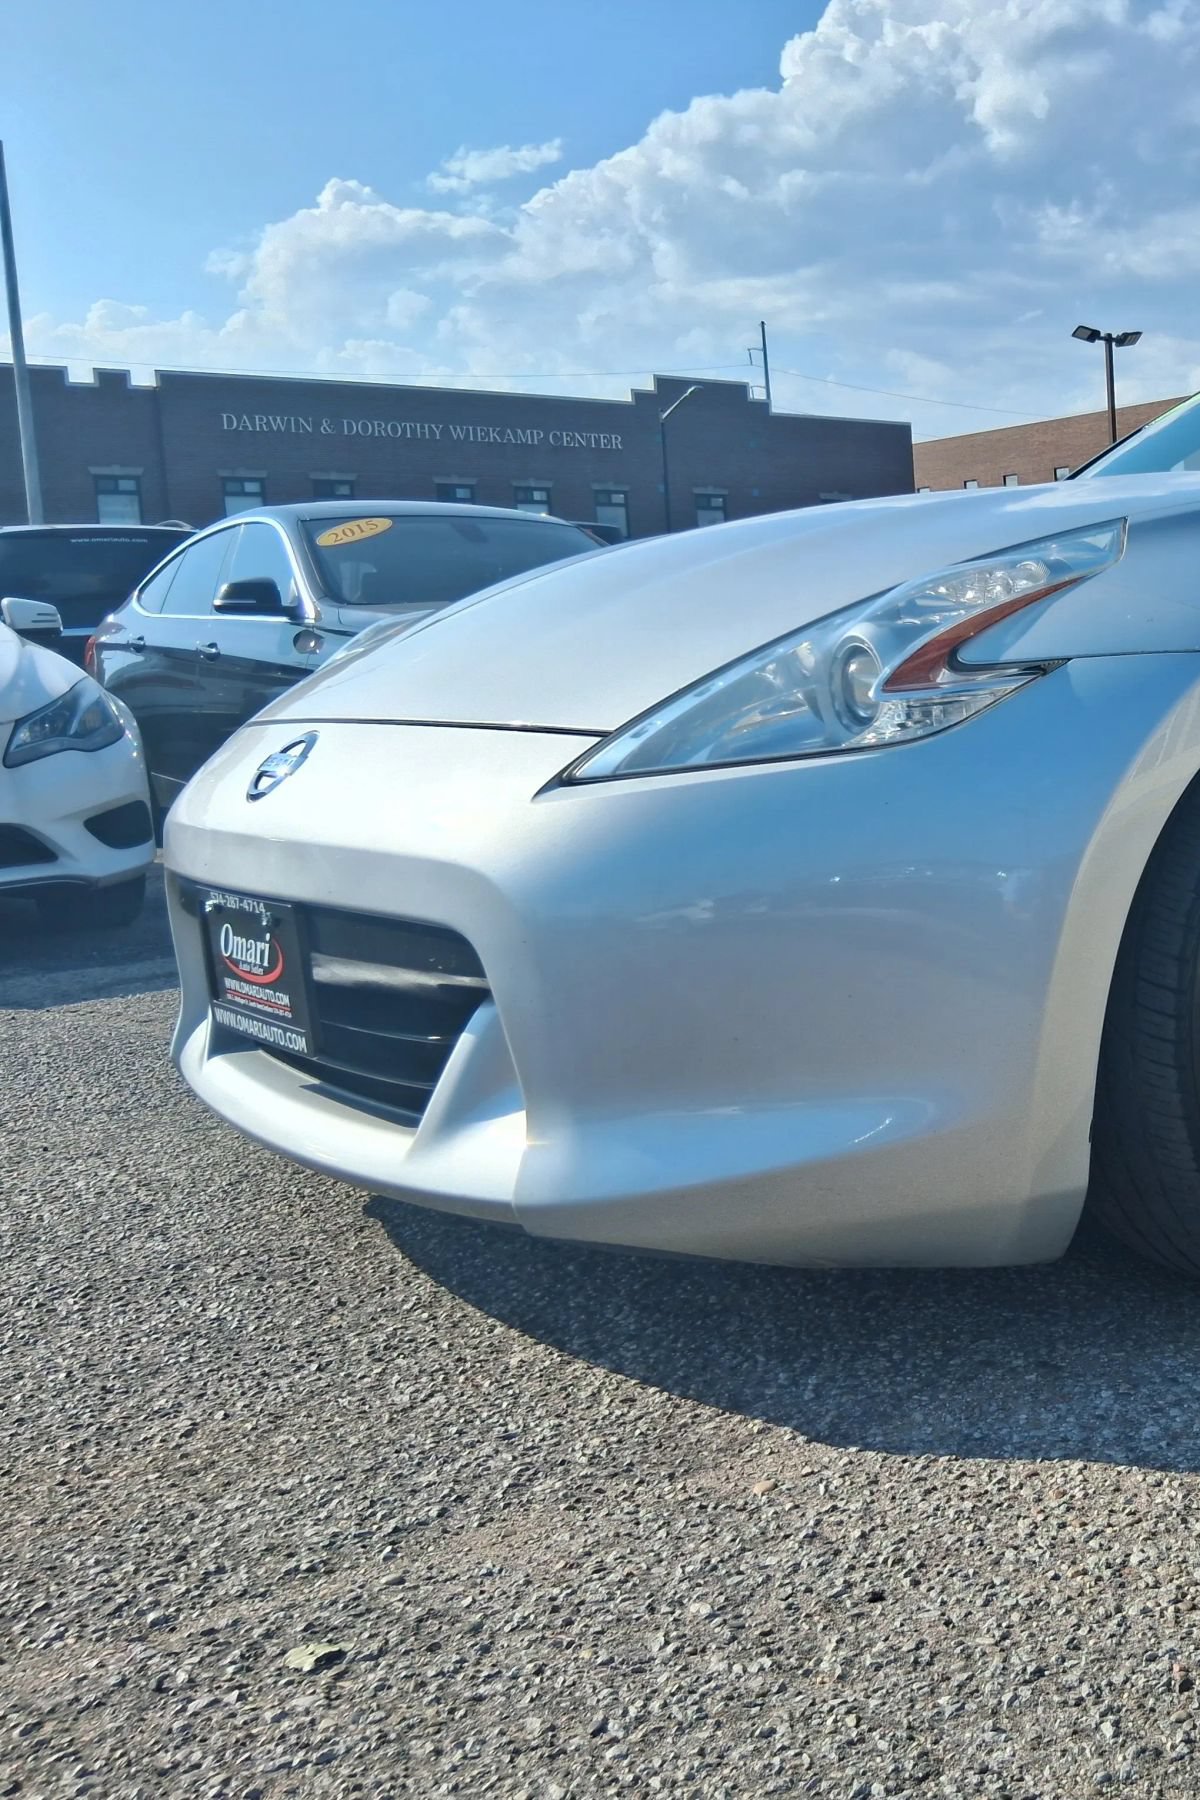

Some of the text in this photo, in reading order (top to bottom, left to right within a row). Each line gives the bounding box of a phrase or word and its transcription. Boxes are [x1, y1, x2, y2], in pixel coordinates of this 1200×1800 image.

[221, 413, 623, 450] DARWIN & DOROTHY WIEKAMP CENTER
[328, 520, 379, 543] 2015
[221, 923, 270, 966] Omari
[214, 1007, 307, 1053] WWW.OMARIAUTO.COM
